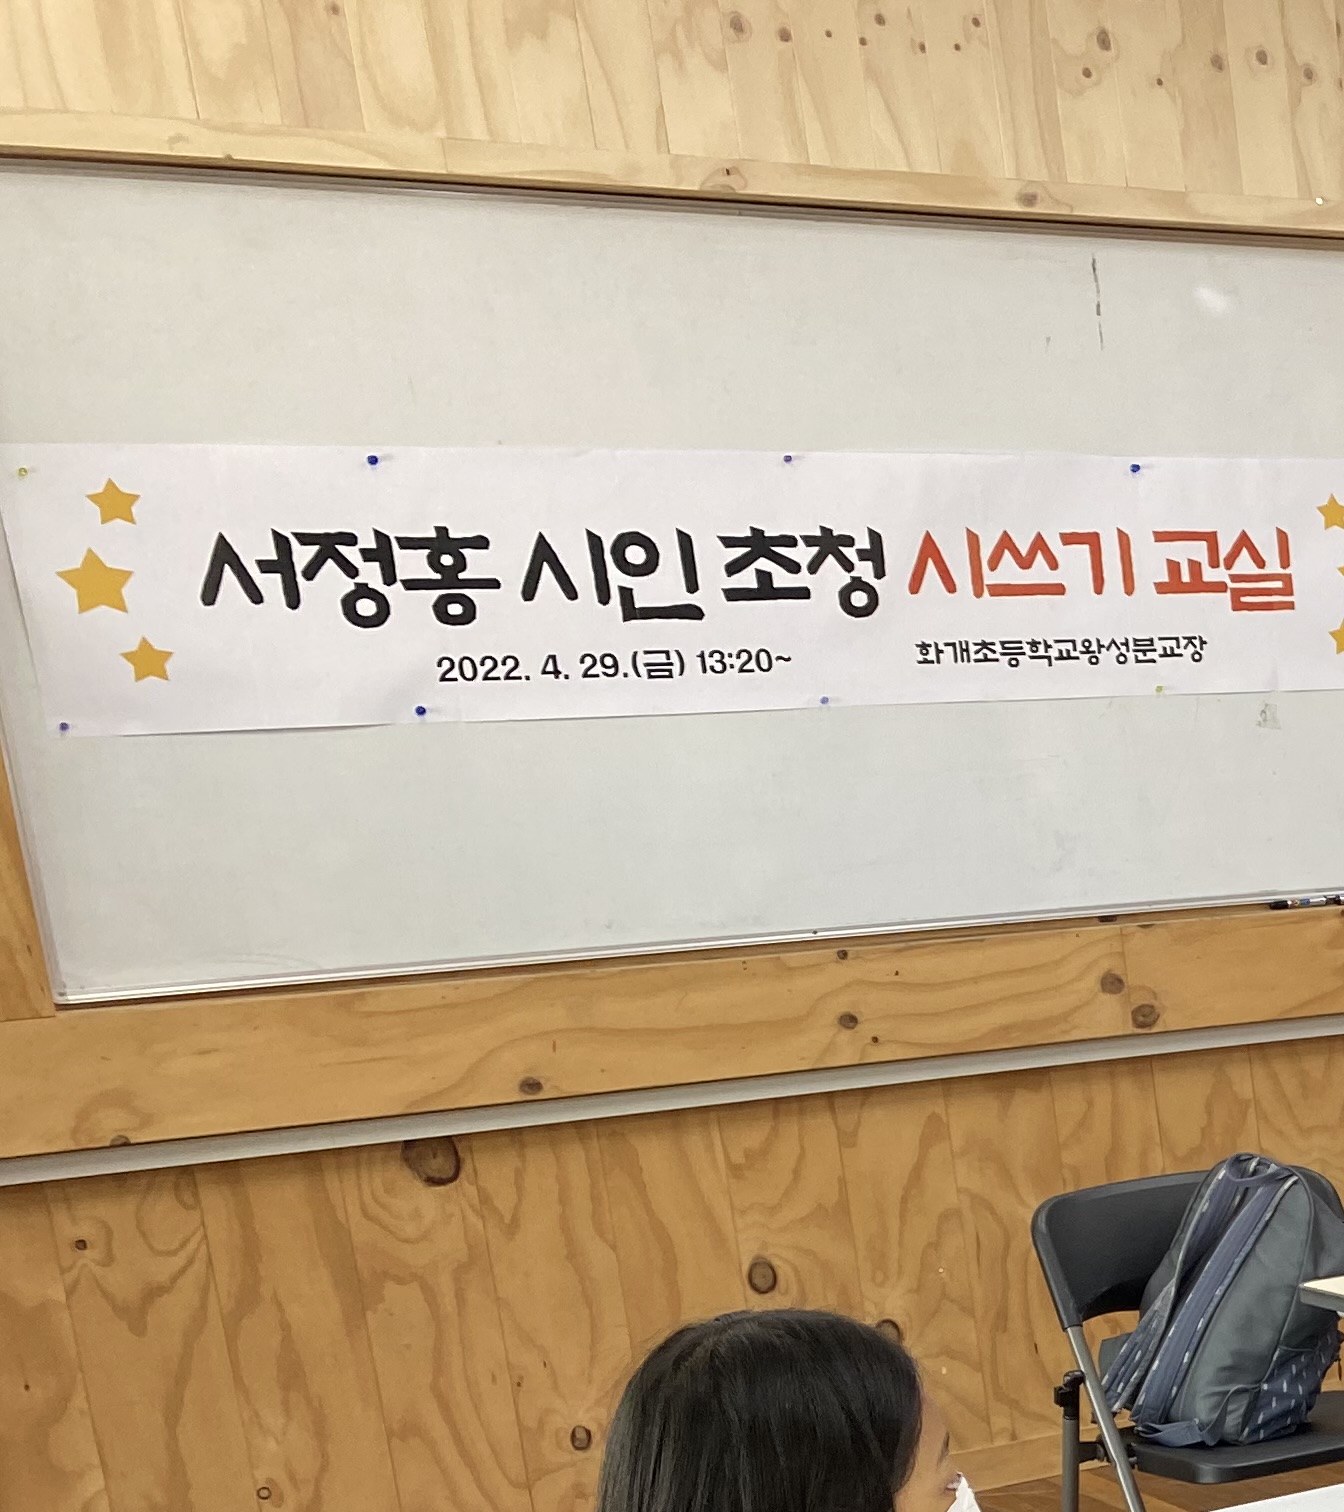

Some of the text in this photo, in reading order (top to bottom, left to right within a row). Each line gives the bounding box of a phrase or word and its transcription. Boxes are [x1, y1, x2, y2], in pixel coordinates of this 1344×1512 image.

[201, 526, 1295, 628] 서정홍 시인 초청 시쓰기 교실
[437, 649, 791, 682] 2022. 4. 29.(금) 13:20~
[915, 636, 1207, 667] 화개초등학교왕성분교장
